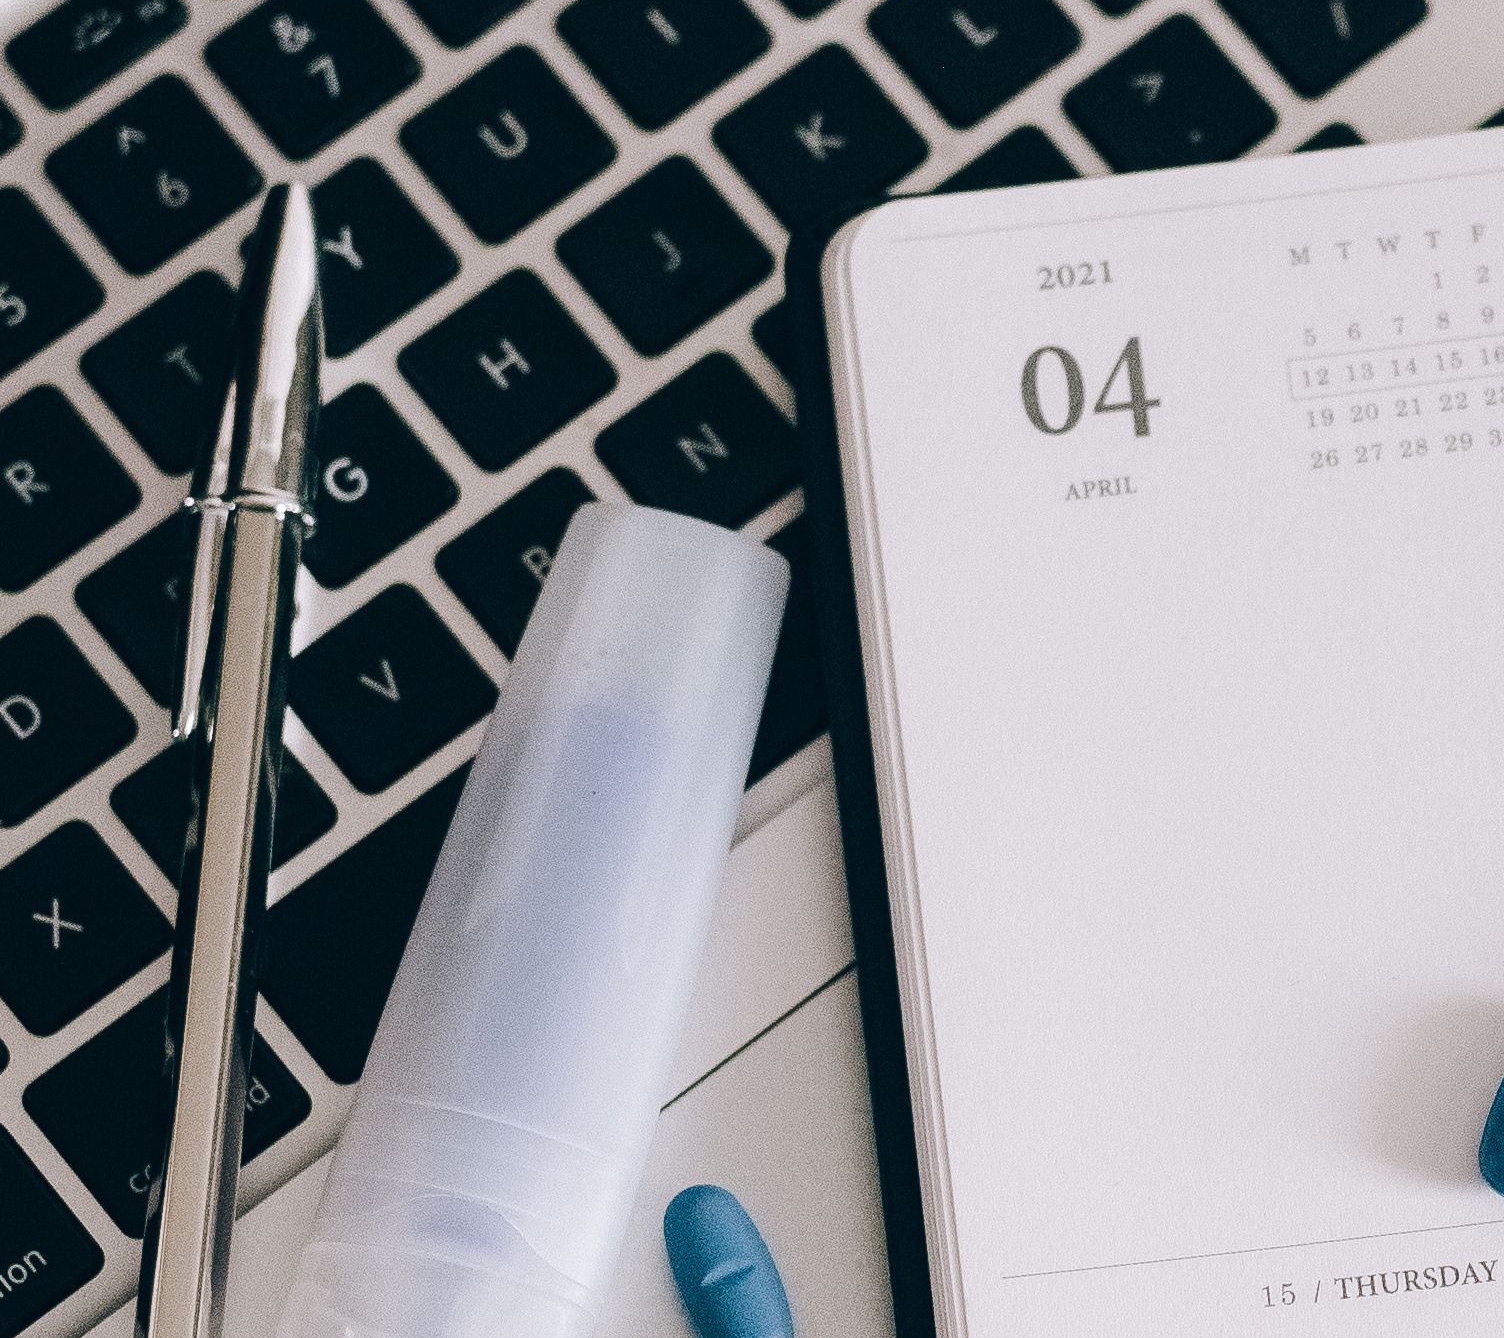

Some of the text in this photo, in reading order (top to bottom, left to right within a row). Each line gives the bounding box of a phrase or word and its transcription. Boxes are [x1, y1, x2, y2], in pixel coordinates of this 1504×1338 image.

[952, 9, 998, 47] L
[308, 55, 340, 96] 7
[480, 112, 528, 159] U
[796, 114, 843, 159] K
[158, 171, 189, 207] 6
[322, 227, 363, 269] Y
[652, 231, 682, 270] J
[1038, 261, 1114, 291] 2021
[165, 344, 201, 382] T
[478, 339, 530, 389] H
[1302, 367, 1330, 387] 12
[1346, 362, 1374, 382] 13
[1392, 358, 1417, 377] 14
[1436, 351, 1463, 371] 15
[1020, 336, 1161, 439] 04
[1307, 408, 1334, 429] 19
[1350, 403, 1379, 423] 20
[1395, 398, 1422, 417] 21
[1439, 391, 1468, 412] 22
[677, 423, 728, 471] N
[1311, 449, 1339, 469] 26
[1355, 443, 1383, 463] 27
[1400, 438, 1428, 459] 28
[1444, 433, 1473, 453] 29
[4, 461, 48, 503] R
[323, 457, 368, 502] G
[1065, 476, 1138, 501] APRIL
[360, 660, 400, 701] V
[32, 898, 83, 949] X
[1263, 1283, 1296, 1307] 15
[1337, 1259, 1498, 1301] THURSDAY
